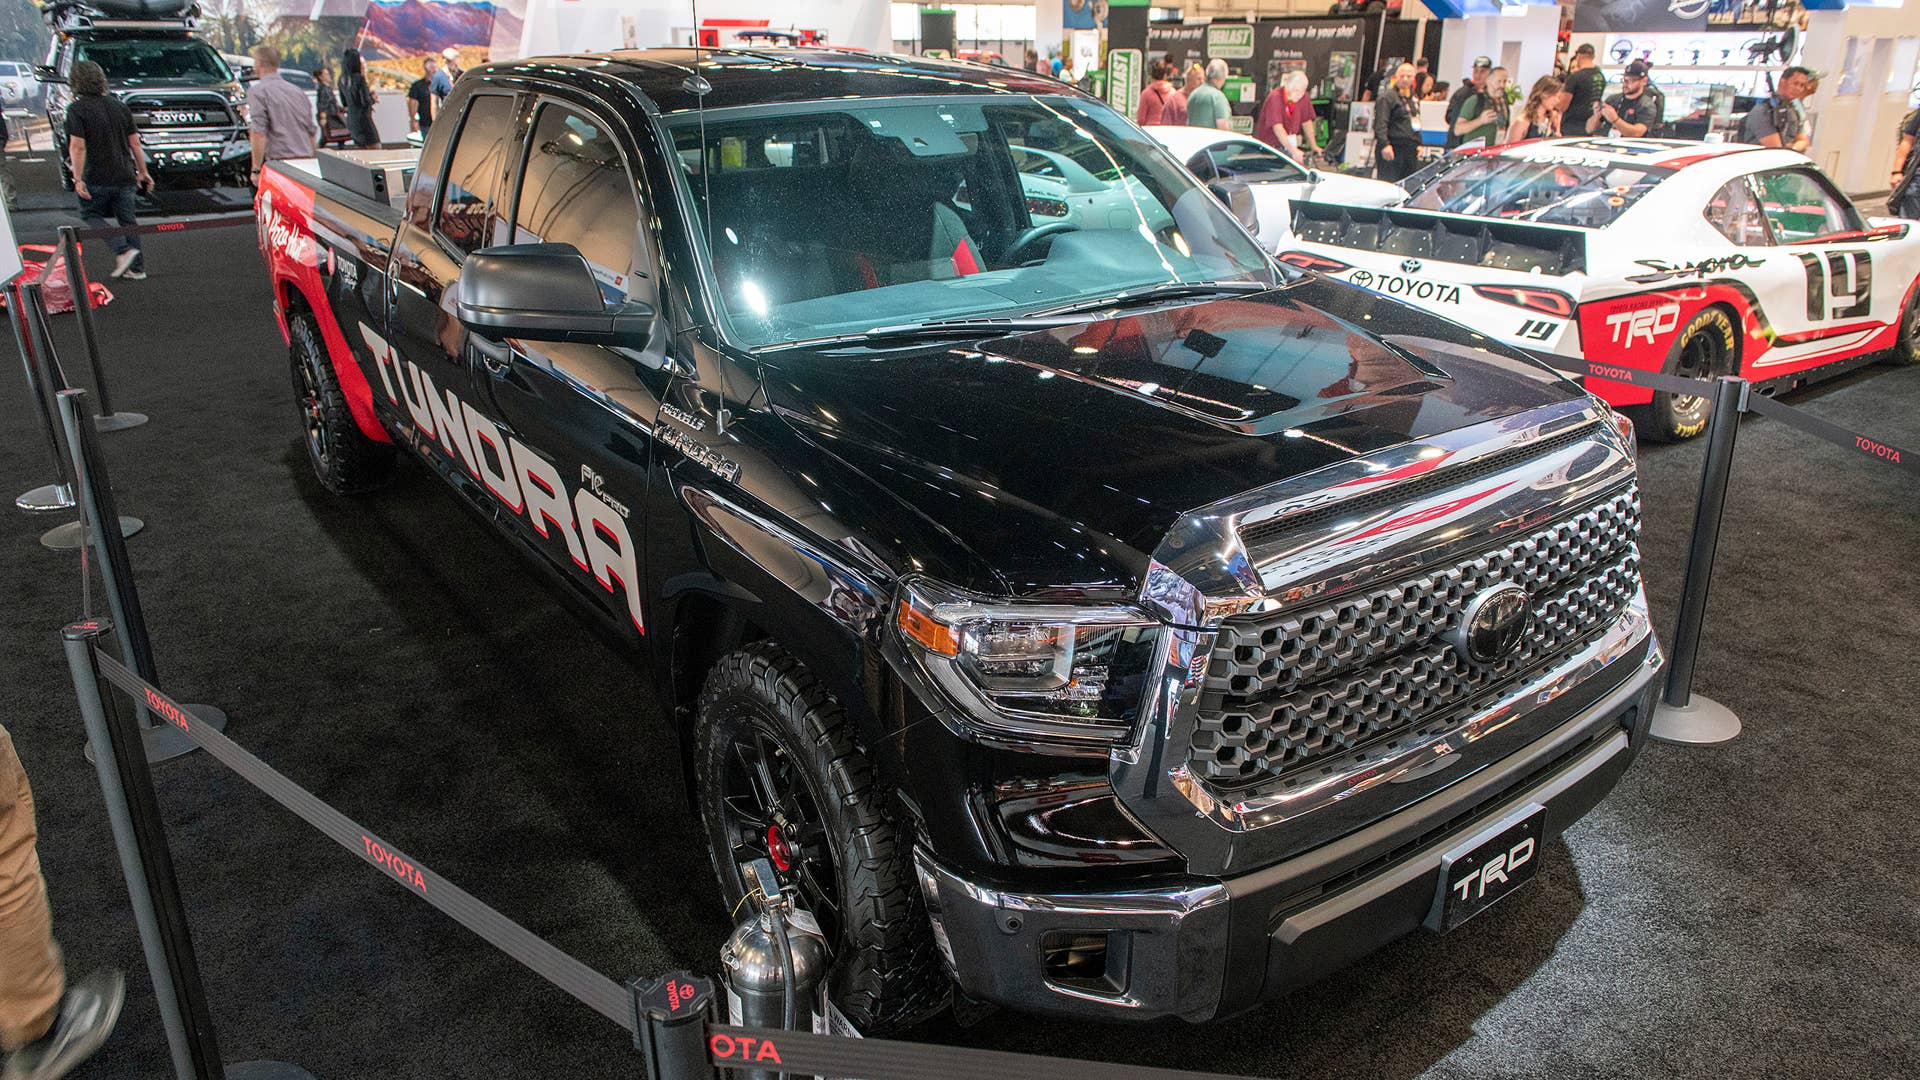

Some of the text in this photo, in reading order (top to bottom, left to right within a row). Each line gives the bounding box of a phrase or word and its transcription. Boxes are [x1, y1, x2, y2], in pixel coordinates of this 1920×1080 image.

[1111, 52, 1129, 111] VERLAST
[155, 112, 203, 122] TOYOTA
[157, 223, 185, 231] TOYOTA
[1625, 253, 1766, 284] Supra
[1378, 274, 1460, 304] TOYOTA
[1790, 249, 1872, 321] 19
[1515, 319, 1560, 341] 19
[1606, 303, 1680, 349] TRD
[1589, 364, 1633, 381] TOYOTA
[1675, 418, 1705, 438] EAGLE
[653, 424, 741, 484] TUNDRA
[1855, 435, 1901, 463] TOYOTA
[358, 321, 644, 636] TUNDRA
[603, 493, 630, 518] PRO
[144, 687, 189, 731] TOYOTA
[362, 835, 427, 893] TOYOTA
[1453, 836, 1535, 901] TRD
[666, 979, 681, 1012] TOYOTA
[709, 1033, 782, 1065] OTA
